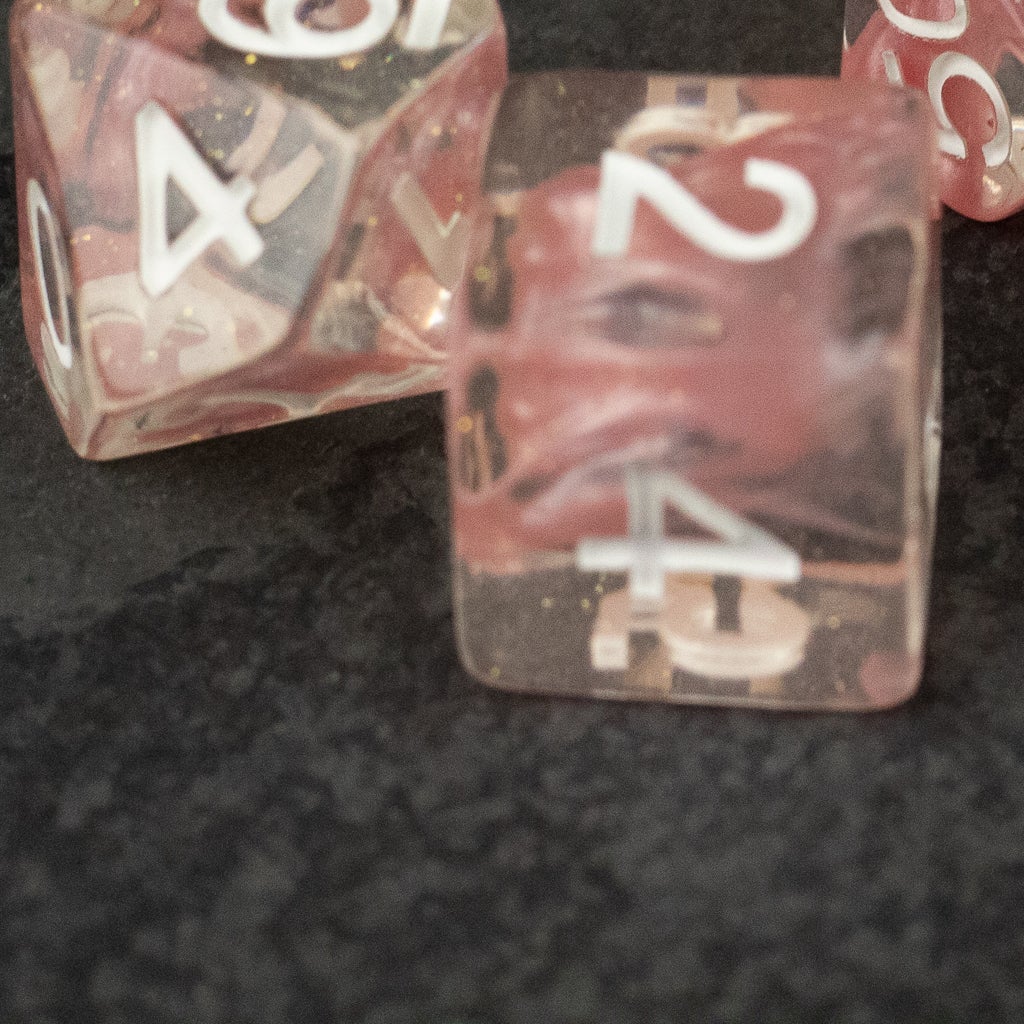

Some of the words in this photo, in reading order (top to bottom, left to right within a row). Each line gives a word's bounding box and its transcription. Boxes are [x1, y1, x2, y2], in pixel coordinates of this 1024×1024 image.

[134, 100, 264, 297] 4
[593, 150, 818, 261] 2
[578, 463, 800, 604] 4
